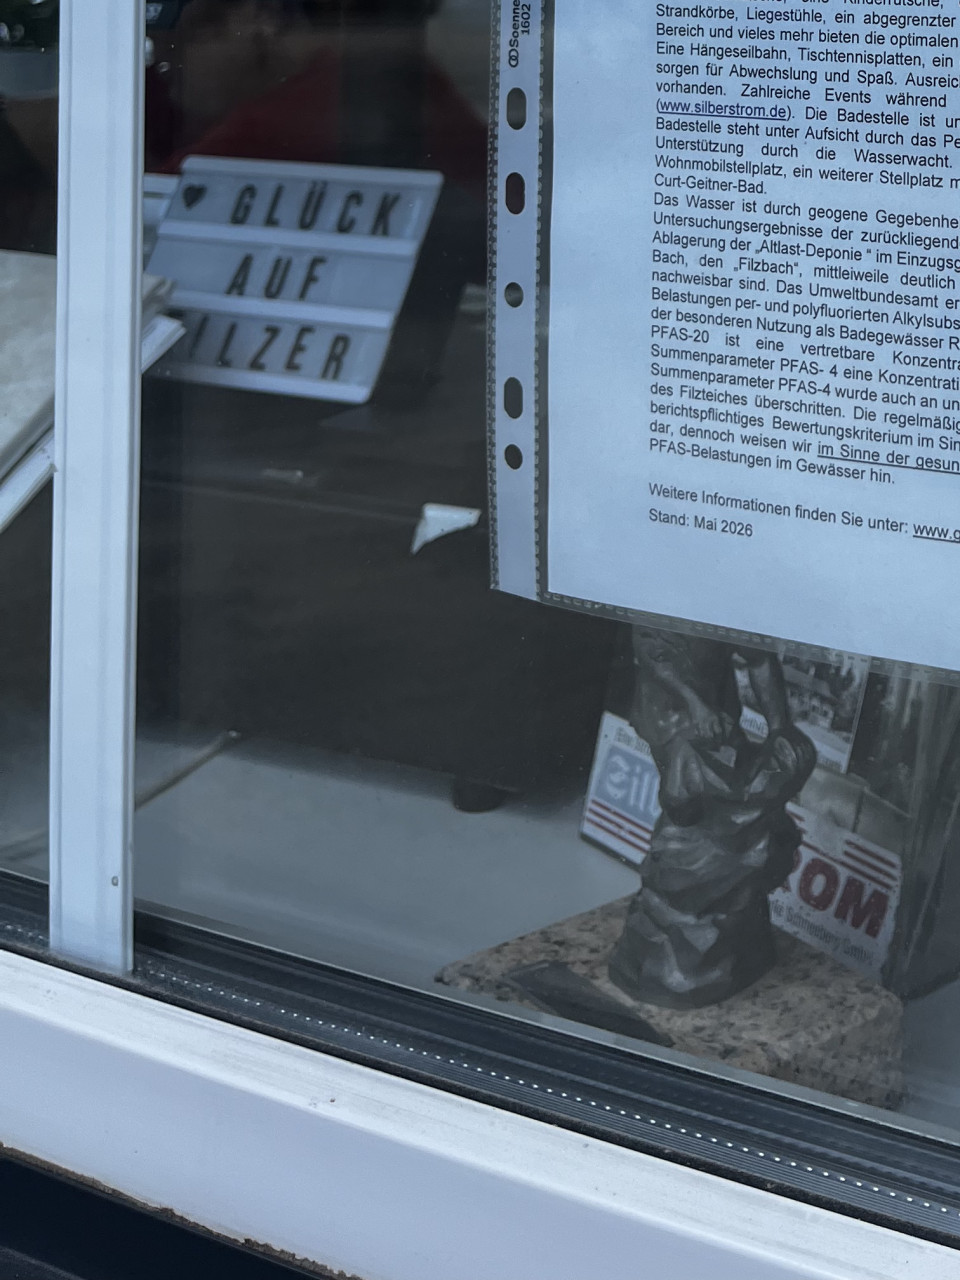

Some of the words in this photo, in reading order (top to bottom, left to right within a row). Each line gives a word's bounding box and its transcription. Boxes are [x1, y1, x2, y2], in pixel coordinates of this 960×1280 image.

[521, 3, 531, 36] 1602
[656, 40, 684, 55] Eine
[690, 42, 790, 62] Hängeseilbahn,
[797, 46, 925, 68] Tischtennisplatten,
[931, 53, 953, 68] ein
[656, 97, 794, 120] (www.silberstrom.de).
[805, 106, 827, 121] Die
[837, 107, 909, 125] Badestelle
[919, 112, 935, 127] ist
[655, 135, 743, 157] Unterstützung
[761, 142, 798, 157] durch
[815, 145, 836, 160] die
[853, 148, 952, 168] Wasserwacht.
[654, 172, 767, 194] Curt-Geitner-Bad.
[231, 180, 401, 238] GLÜCK
[653, 211, 823, 238] Untersuchungsergebnisse
[830, 225, 853, 241] der
[224, 253, 327, 302] AUF
[651, 269, 733, 288] nachweisbar
[738, 277, 769, 292] sind.
[776, 279, 803, 295] Das
[809, 282, 938, 308] Umweltbundesamt
[184, 312, 352, 381] ILZER
[651, 324, 709, 343] PFAS-20
[725, 334, 740, 347] ist
[755, 336, 784, 352] eine
[800, 342, 874, 362] vertretbare
[650, 400, 764, 429] berichtspflichtiges
[772, 415, 913, 446] Bewertungskriterium
[917, 433, 934, 448] im
[649, 437, 771, 468] PFAS-Belastungen
[776, 454, 791, 470] im
[795, 457, 866, 480] Gewässer
[870, 467, 894, 484] hin.
[648, 482, 697, 502] Weitere
[702, 490, 790, 516] Informationen
[794, 503, 836, 523] finden
[841, 510, 863, 527] Sie
[867, 517, 908, 533] unter:
[648, 507, 689, 526] Stand:
[693, 514, 717, 531] Mai
[720, 519, 753, 538] 2026
[790, 849, 889, 939] OM
